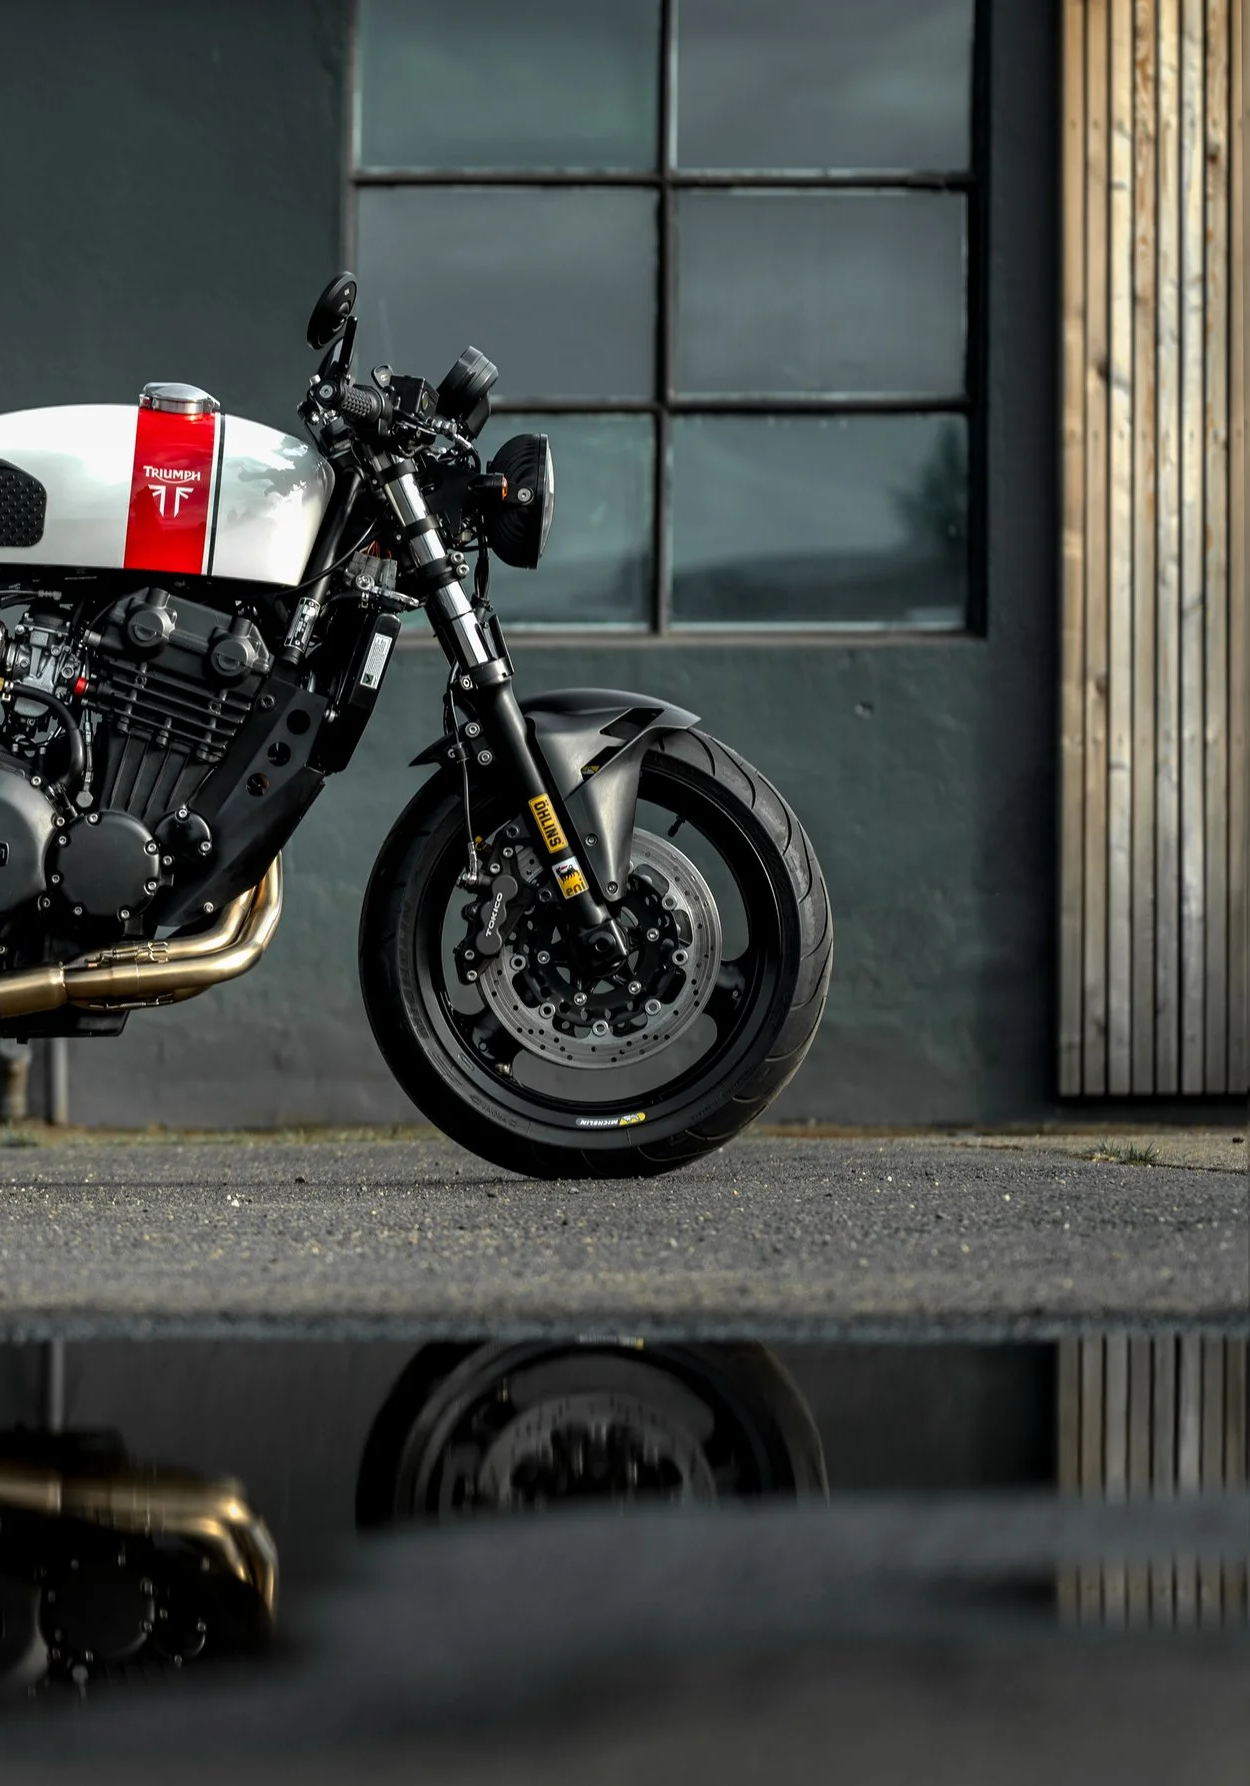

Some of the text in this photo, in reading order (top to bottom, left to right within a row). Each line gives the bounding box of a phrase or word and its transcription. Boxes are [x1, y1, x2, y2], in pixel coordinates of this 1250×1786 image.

[143, 465, 201, 484] TRIUMPH
[533, 799, 562, 848] ÖHLINS
[565, 878, 586, 897] eni
[485, 892, 503, 937] TOKICO
[579, 1118, 619, 1126] MICHELIN
